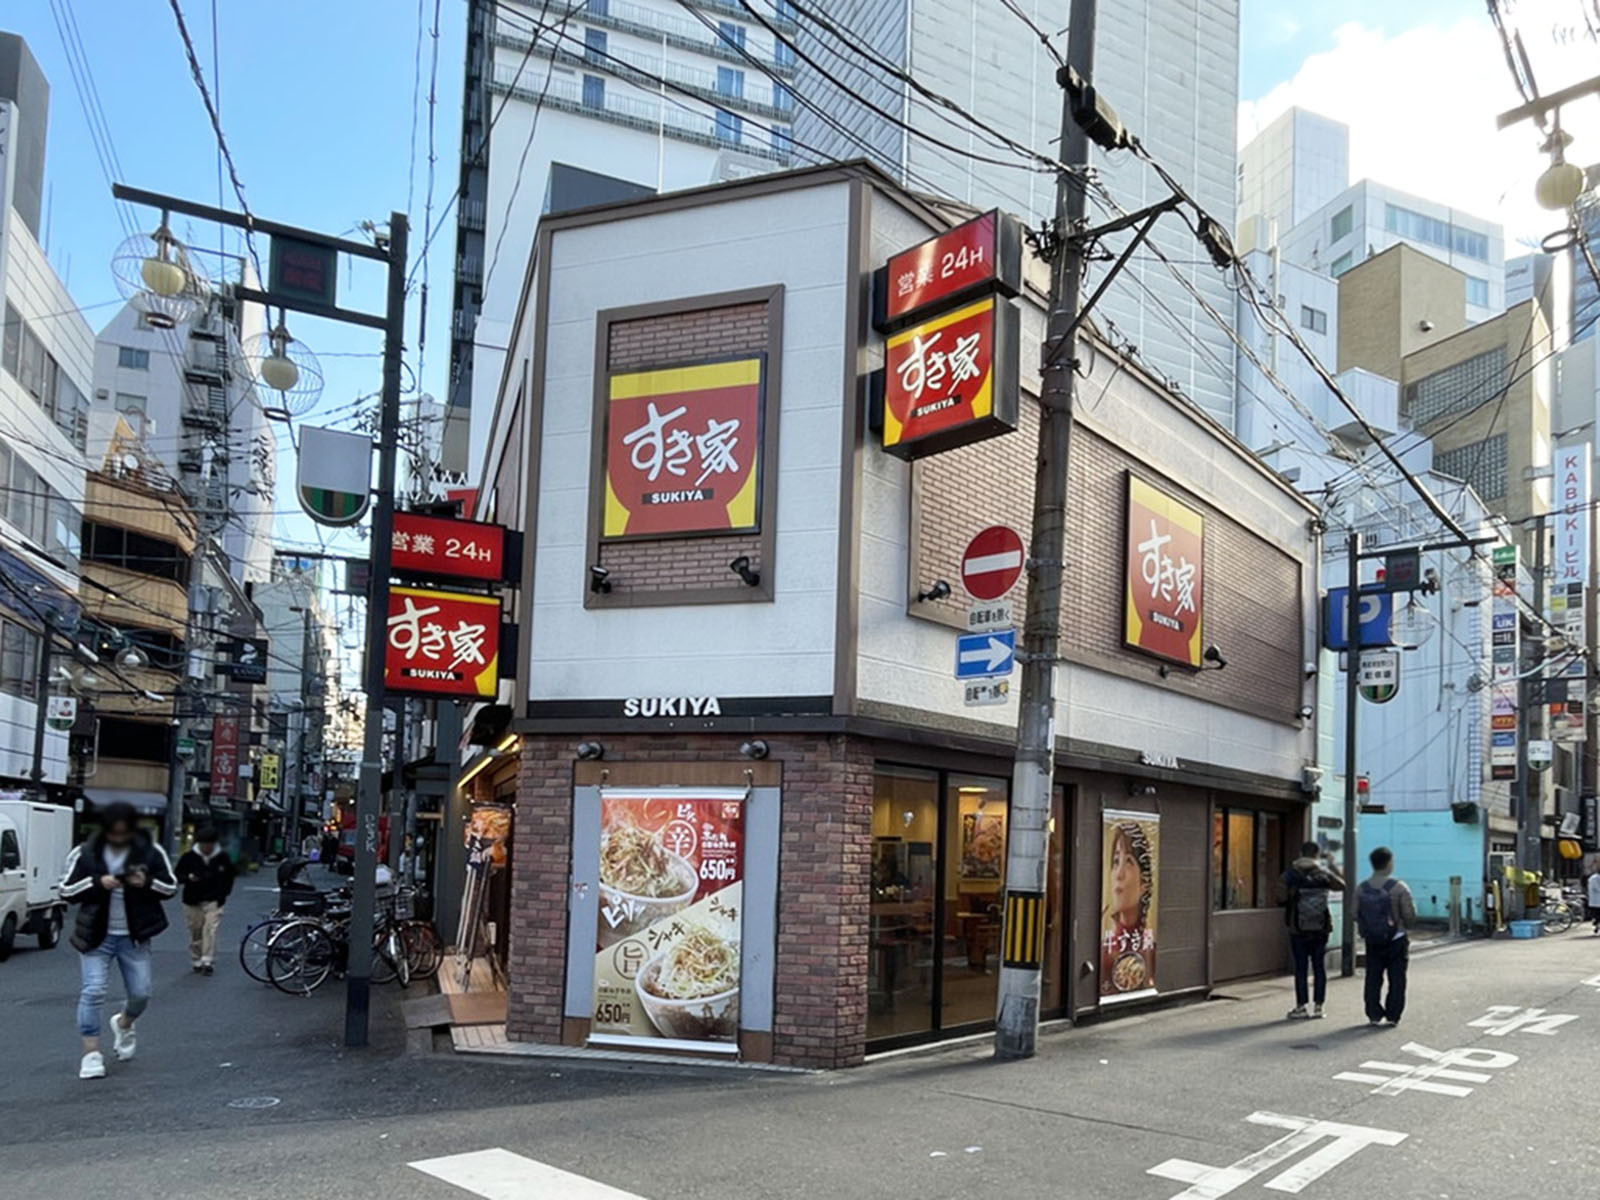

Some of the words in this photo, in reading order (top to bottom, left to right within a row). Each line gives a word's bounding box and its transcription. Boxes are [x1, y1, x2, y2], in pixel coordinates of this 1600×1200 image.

[897, 266, 934, 297] 営業
[940, 246, 984, 279] 24H
[896, 332, 981, 399] すき家
[916, 398, 955, 417] SUKIYA
[622, 402, 741, 487] すき家
[651, 489, 704, 504] SUKIYA
[1564, 455, 1580, 580] KABUKIビル
[392, 530, 435, 555] 営業
[445, 538, 492, 562] 24H
[1137, 518, 1196, 617] すき家
[387, 597, 486, 670] すき家
[409, 667, 456, 681] SUKIYA
[623, 697, 721, 717] SUKIYA
